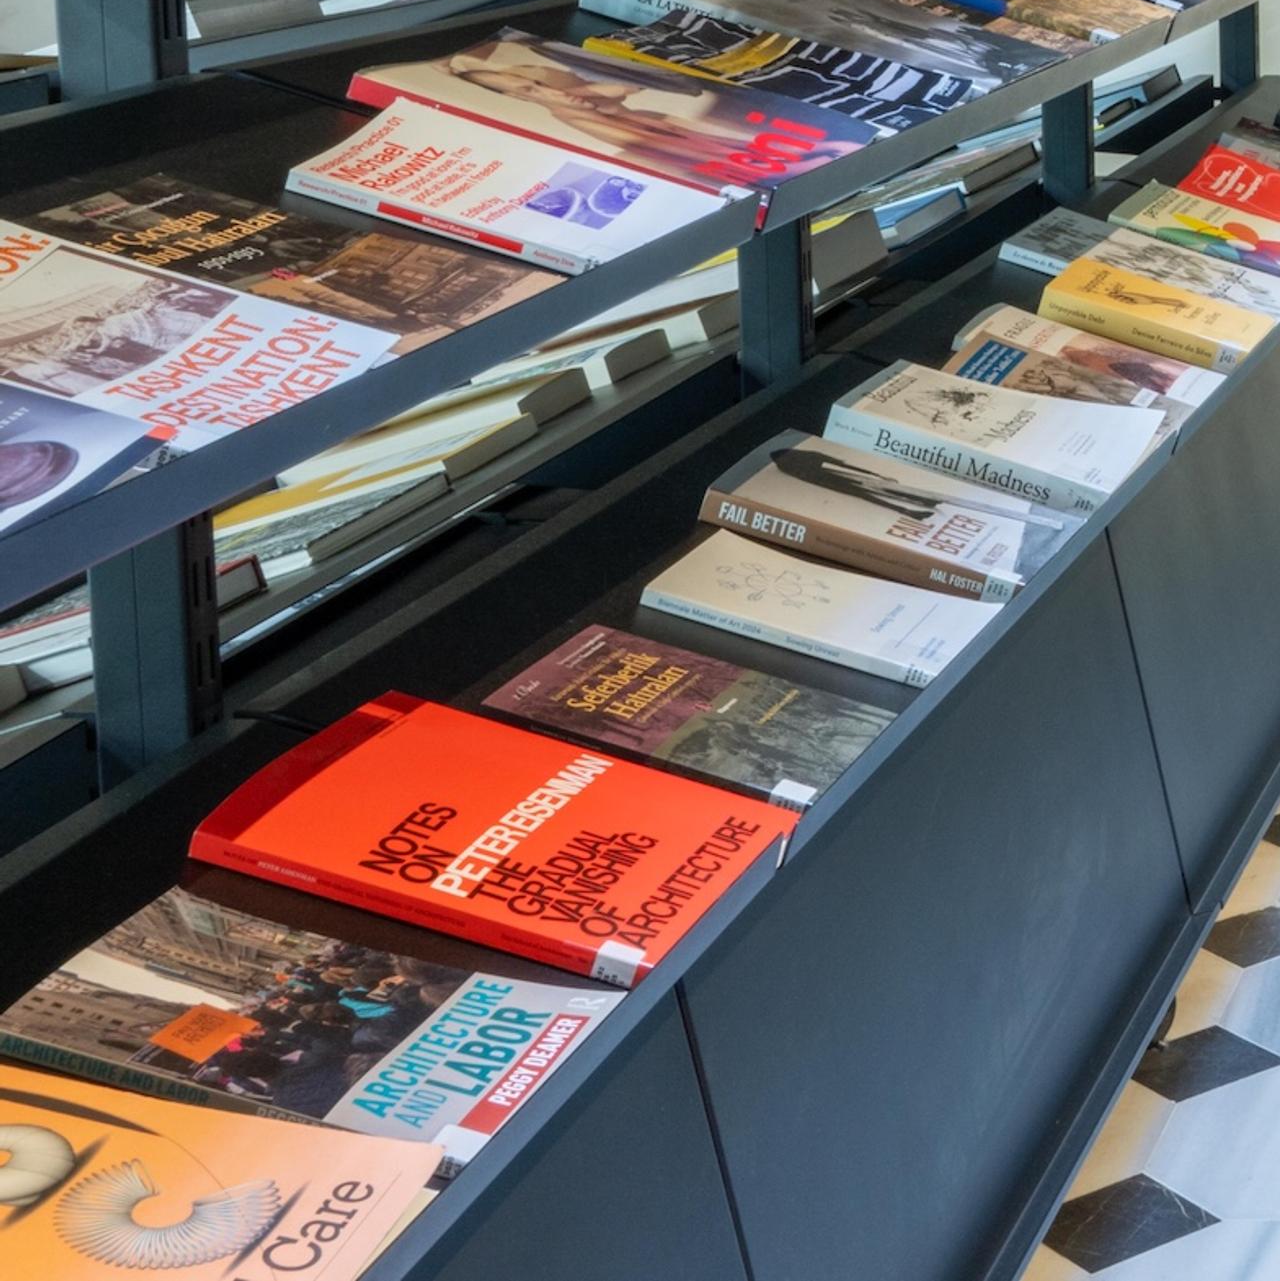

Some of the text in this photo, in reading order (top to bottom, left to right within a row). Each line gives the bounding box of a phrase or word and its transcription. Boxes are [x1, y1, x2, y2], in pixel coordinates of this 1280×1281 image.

[329, 141, 409, 182] Michael
[360, 146, 446, 191] Rakowitz
[102, 314, 264, 402] TASHKENT
[139, 315, 339, 429] DESTINATION:
[207, 340, 361, 430] TASHKENT
[874, 428, 963, 472] Beautiful
[966, 458, 1051, 501] Madness
[718, 499, 750, 529] FAIL
[751, 510, 807, 544] BETTER
[929, 568, 949, 584] HAL
[949, 573, 984, 594] FOSTER
[886, 517, 935, 544] FAIL
[925, 513, 988, 556] BETTER
[567, 653, 663, 712] Seferberlik
[358, 802, 458, 877] NOTES
[399, 844, 455, 886] ON
[431, 754, 614, 898] PETER EISENMAN
[467, 855, 539, 904] THE
[506, 828, 622, 918] GRADUAL
[540, 831, 660, 926] VANISHING
[617, 815, 762, 950] ARCHITECTURE
[580, 903, 631, 939] OF
[0, 1033, 211, 1109] ARCHITECTURE AND LABOR
[352, 979, 514, 1120] ARCHITECTURE
[394, 1005, 552, 1129] AND LABOR
[488, 1015, 584, 1107] PEGGY DEAMER
[262, 1179, 376, 1273] Care
